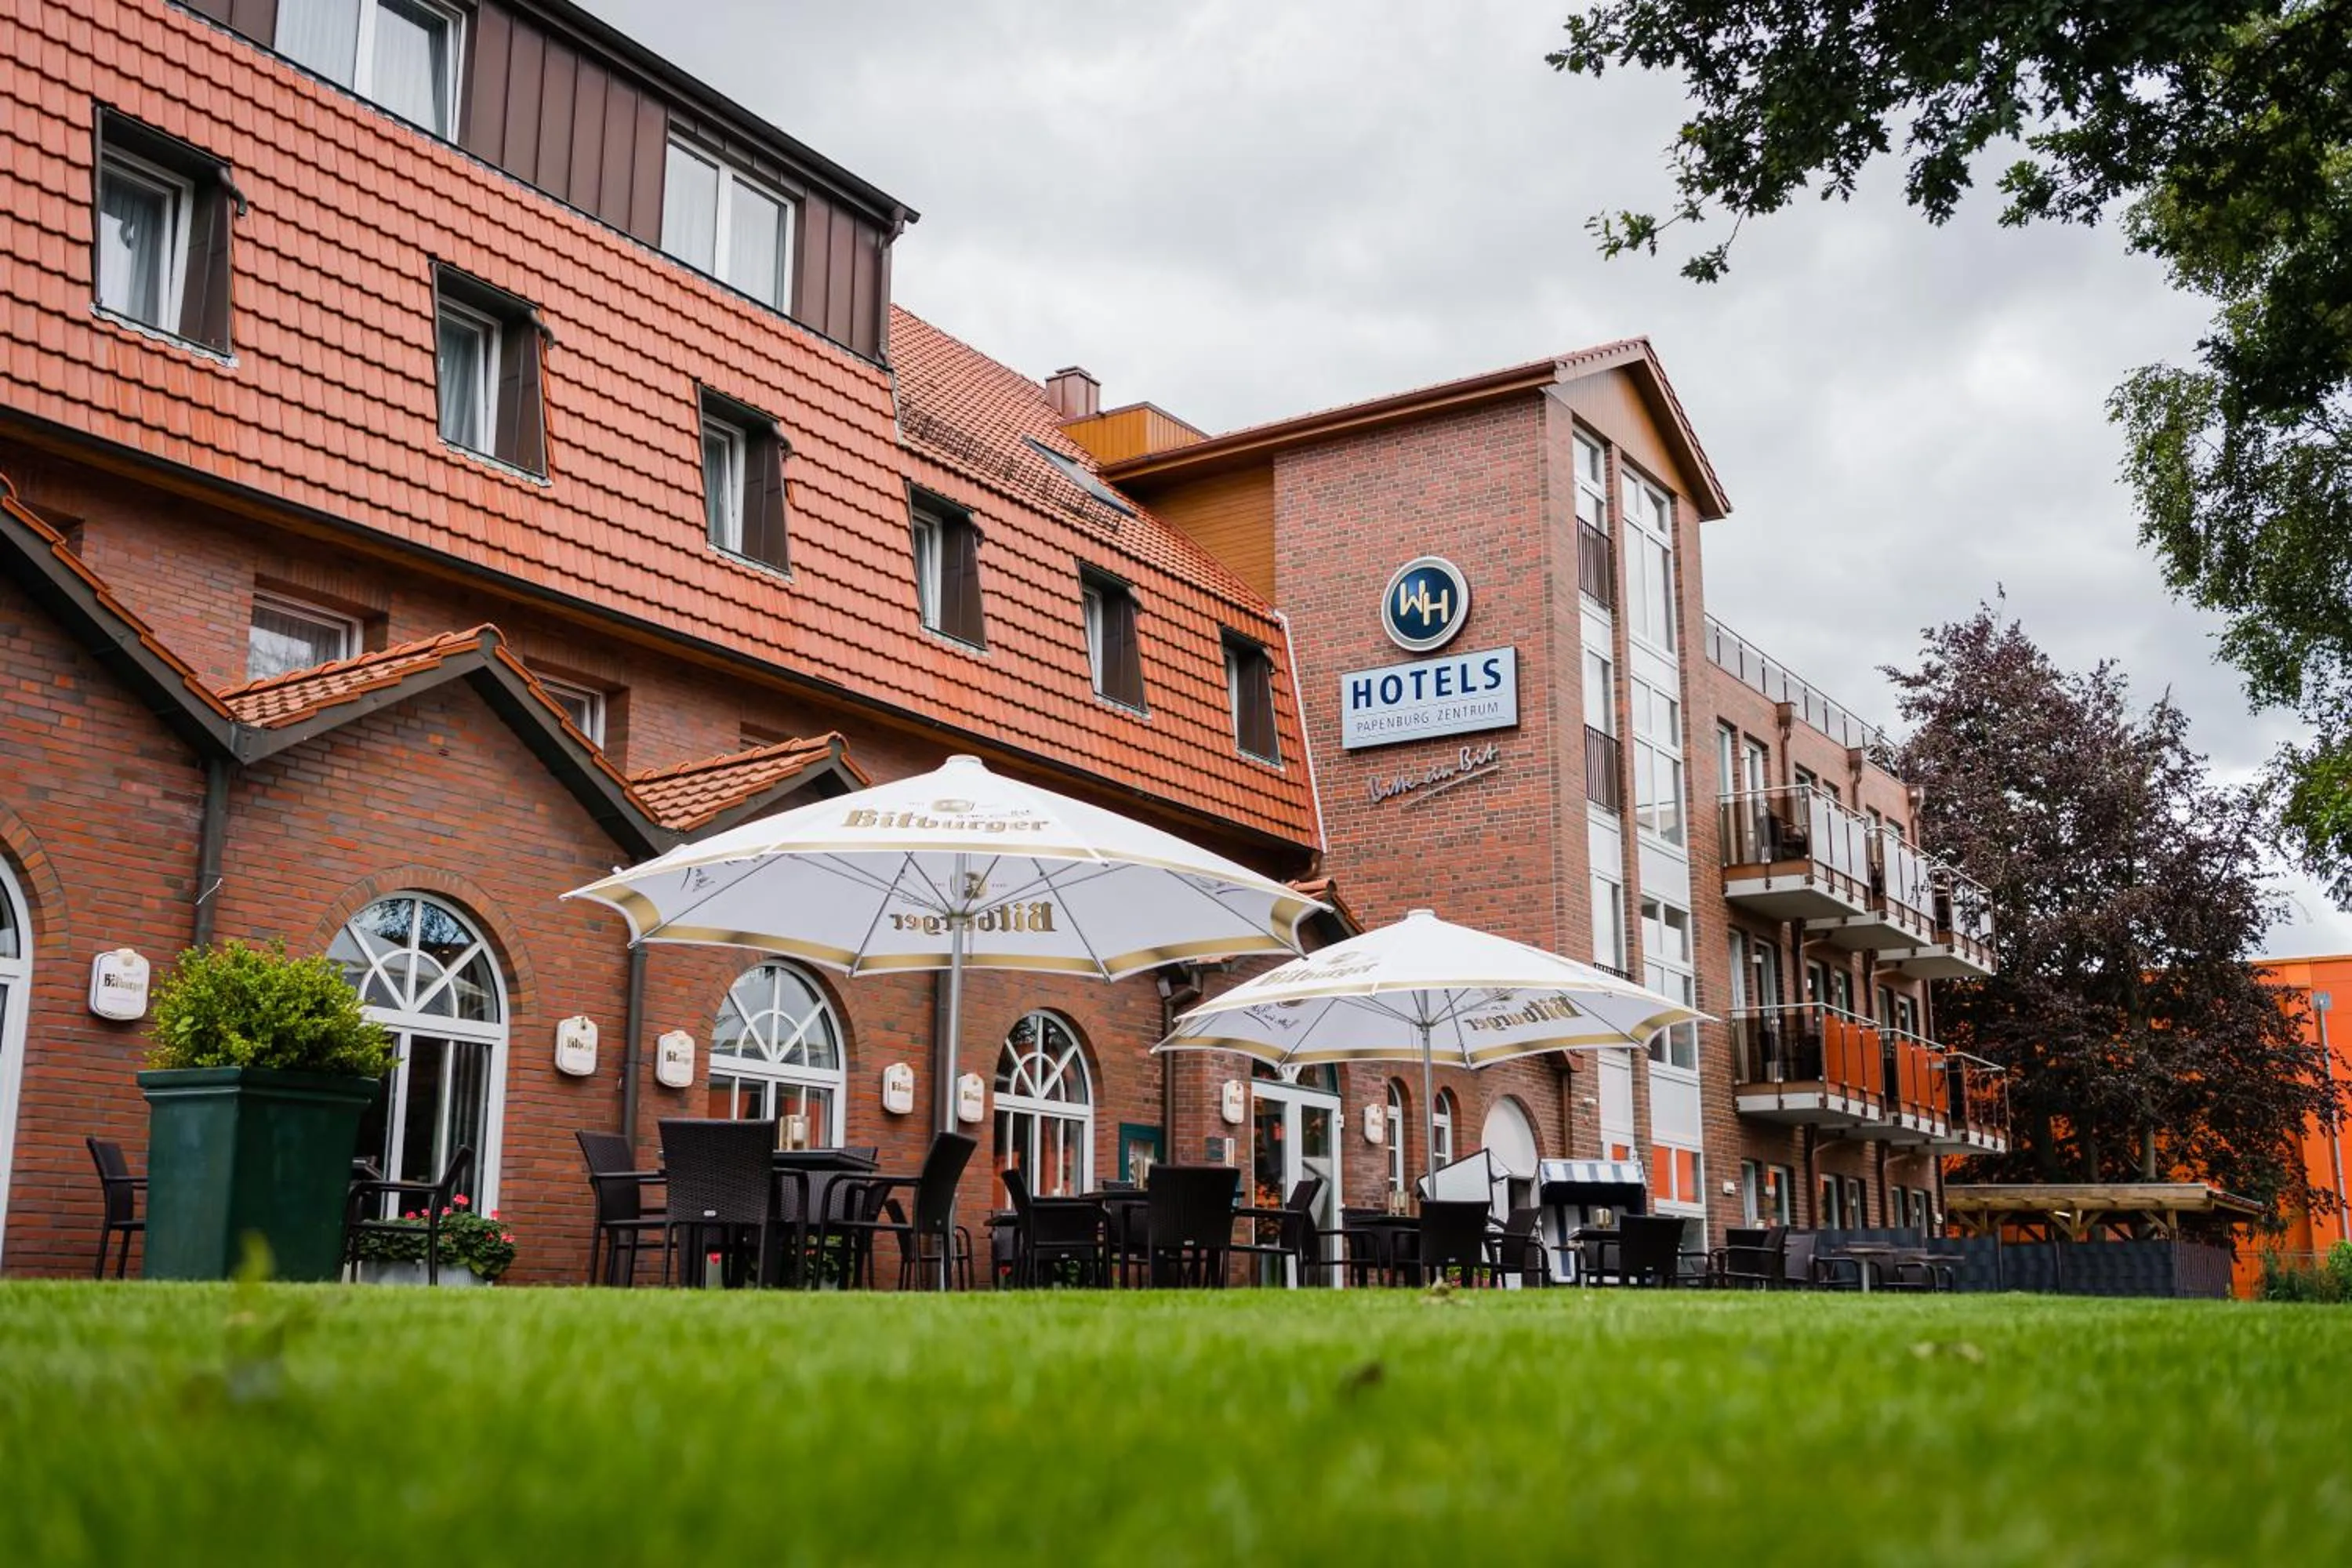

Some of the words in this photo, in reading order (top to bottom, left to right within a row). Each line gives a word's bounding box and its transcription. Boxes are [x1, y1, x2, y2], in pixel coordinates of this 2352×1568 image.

[1352, 658, 1502, 710] HOTELS
[1356, 712, 1430, 733] PAPENBURG
[1436, 702, 1499, 721] ZENTRUM
[1459, 741, 1499, 771] Bit
[841, 808, 1050, 833] Bitburger
